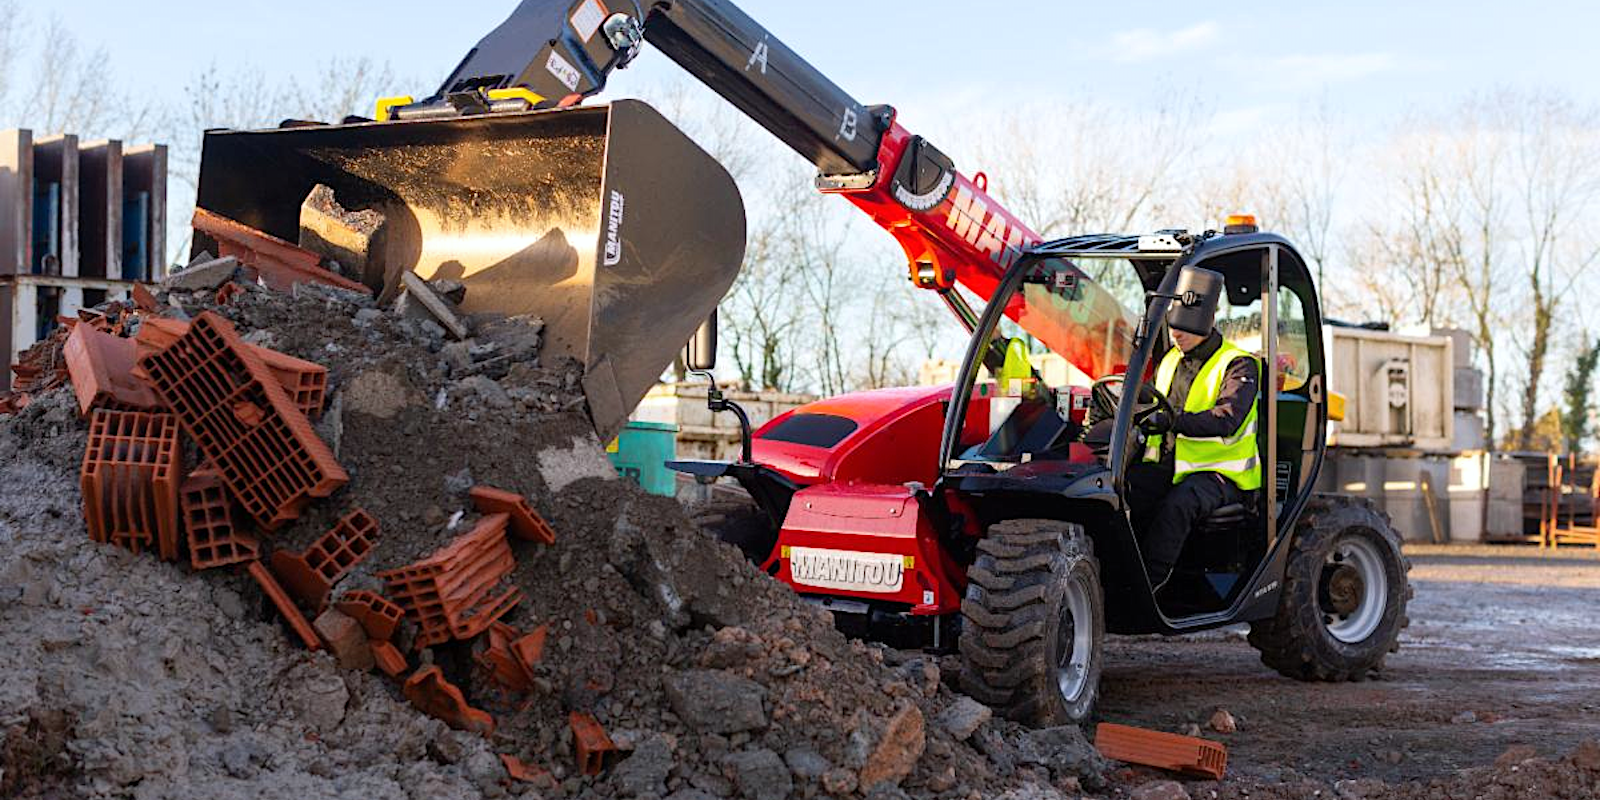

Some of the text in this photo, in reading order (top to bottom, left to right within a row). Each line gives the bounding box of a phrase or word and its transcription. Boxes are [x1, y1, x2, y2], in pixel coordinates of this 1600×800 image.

[749, 42, 768, 74] A
[840, 108, 857, 141] B
[606, 189, 620, 257] MANITOU
[795, 552, 901, 586] MANITOU
